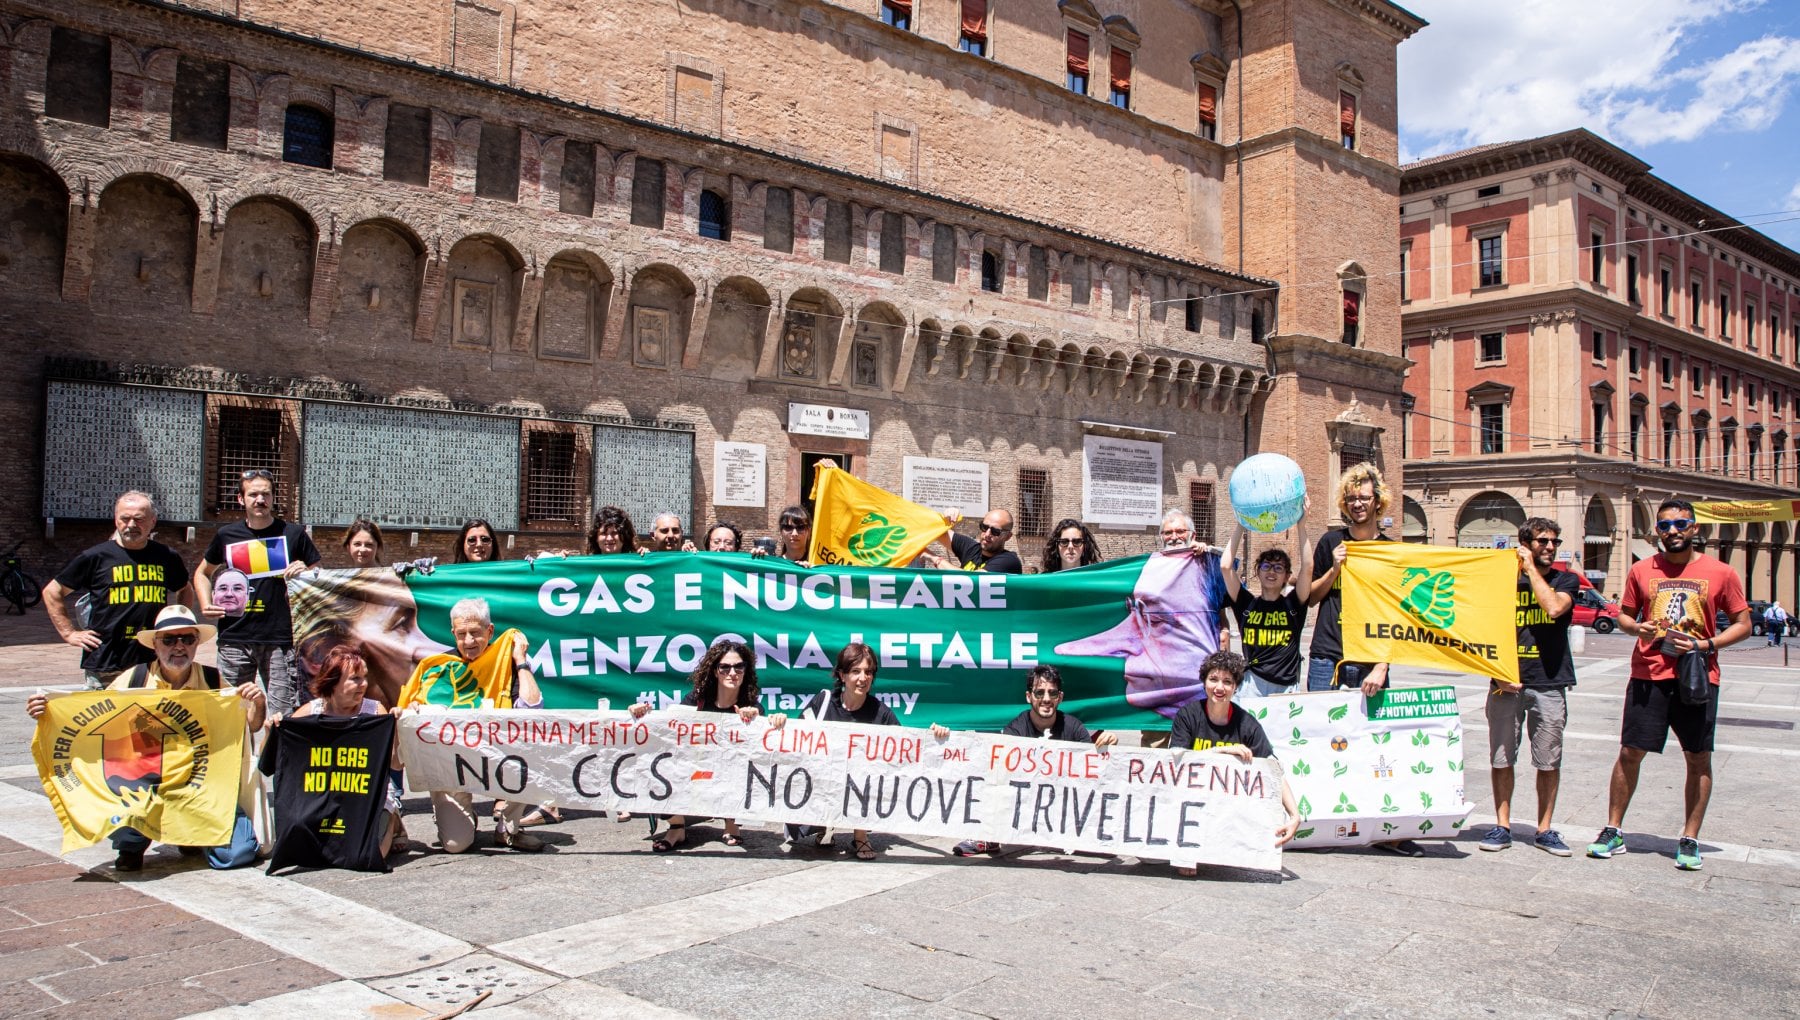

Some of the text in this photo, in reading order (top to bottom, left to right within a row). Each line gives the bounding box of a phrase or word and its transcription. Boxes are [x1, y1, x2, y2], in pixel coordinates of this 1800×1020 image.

[805, 409, 859, 420] SALA BORSA
[112, 564, 165, 583] NO GAS
[109, 585, 166, 605] NO NUKE
[538, 571, 1007, 616] GAS E NUCLEARE
[1247, 610, 1288, 626] NO GAS
[1258, 628, 1293, 647] NUKE
[524, 631, 833, 678] MENZONA
[1388, 690, 1420, 704] TROVA
[53, 698, 117, 759] PER IL CLIMA
[156, 697, 209, 789] FUORI DAL FOSSILE
[310, 747, 369, 768] NO GAS
[416, 720, 649, 748] COORDINAMENTO
[729, 731, 745, 744] IL
[762, 728, 829, 756] CLIMA
[848, 733, 922, 764] FUORI
[943, 748, 970, 762] DAL
[1128, 758, 1265, 799] RAVENNA
[304, 771, 371, 794] NO NUKE
[455, 752, 529, 795] NO
[572, 752, 673, 801] CCS
[743, 759, 814, 810] NO
[842, 772, 985, 825] NUOVE
[1008, 779, 1207, 848] TRIVELLE
